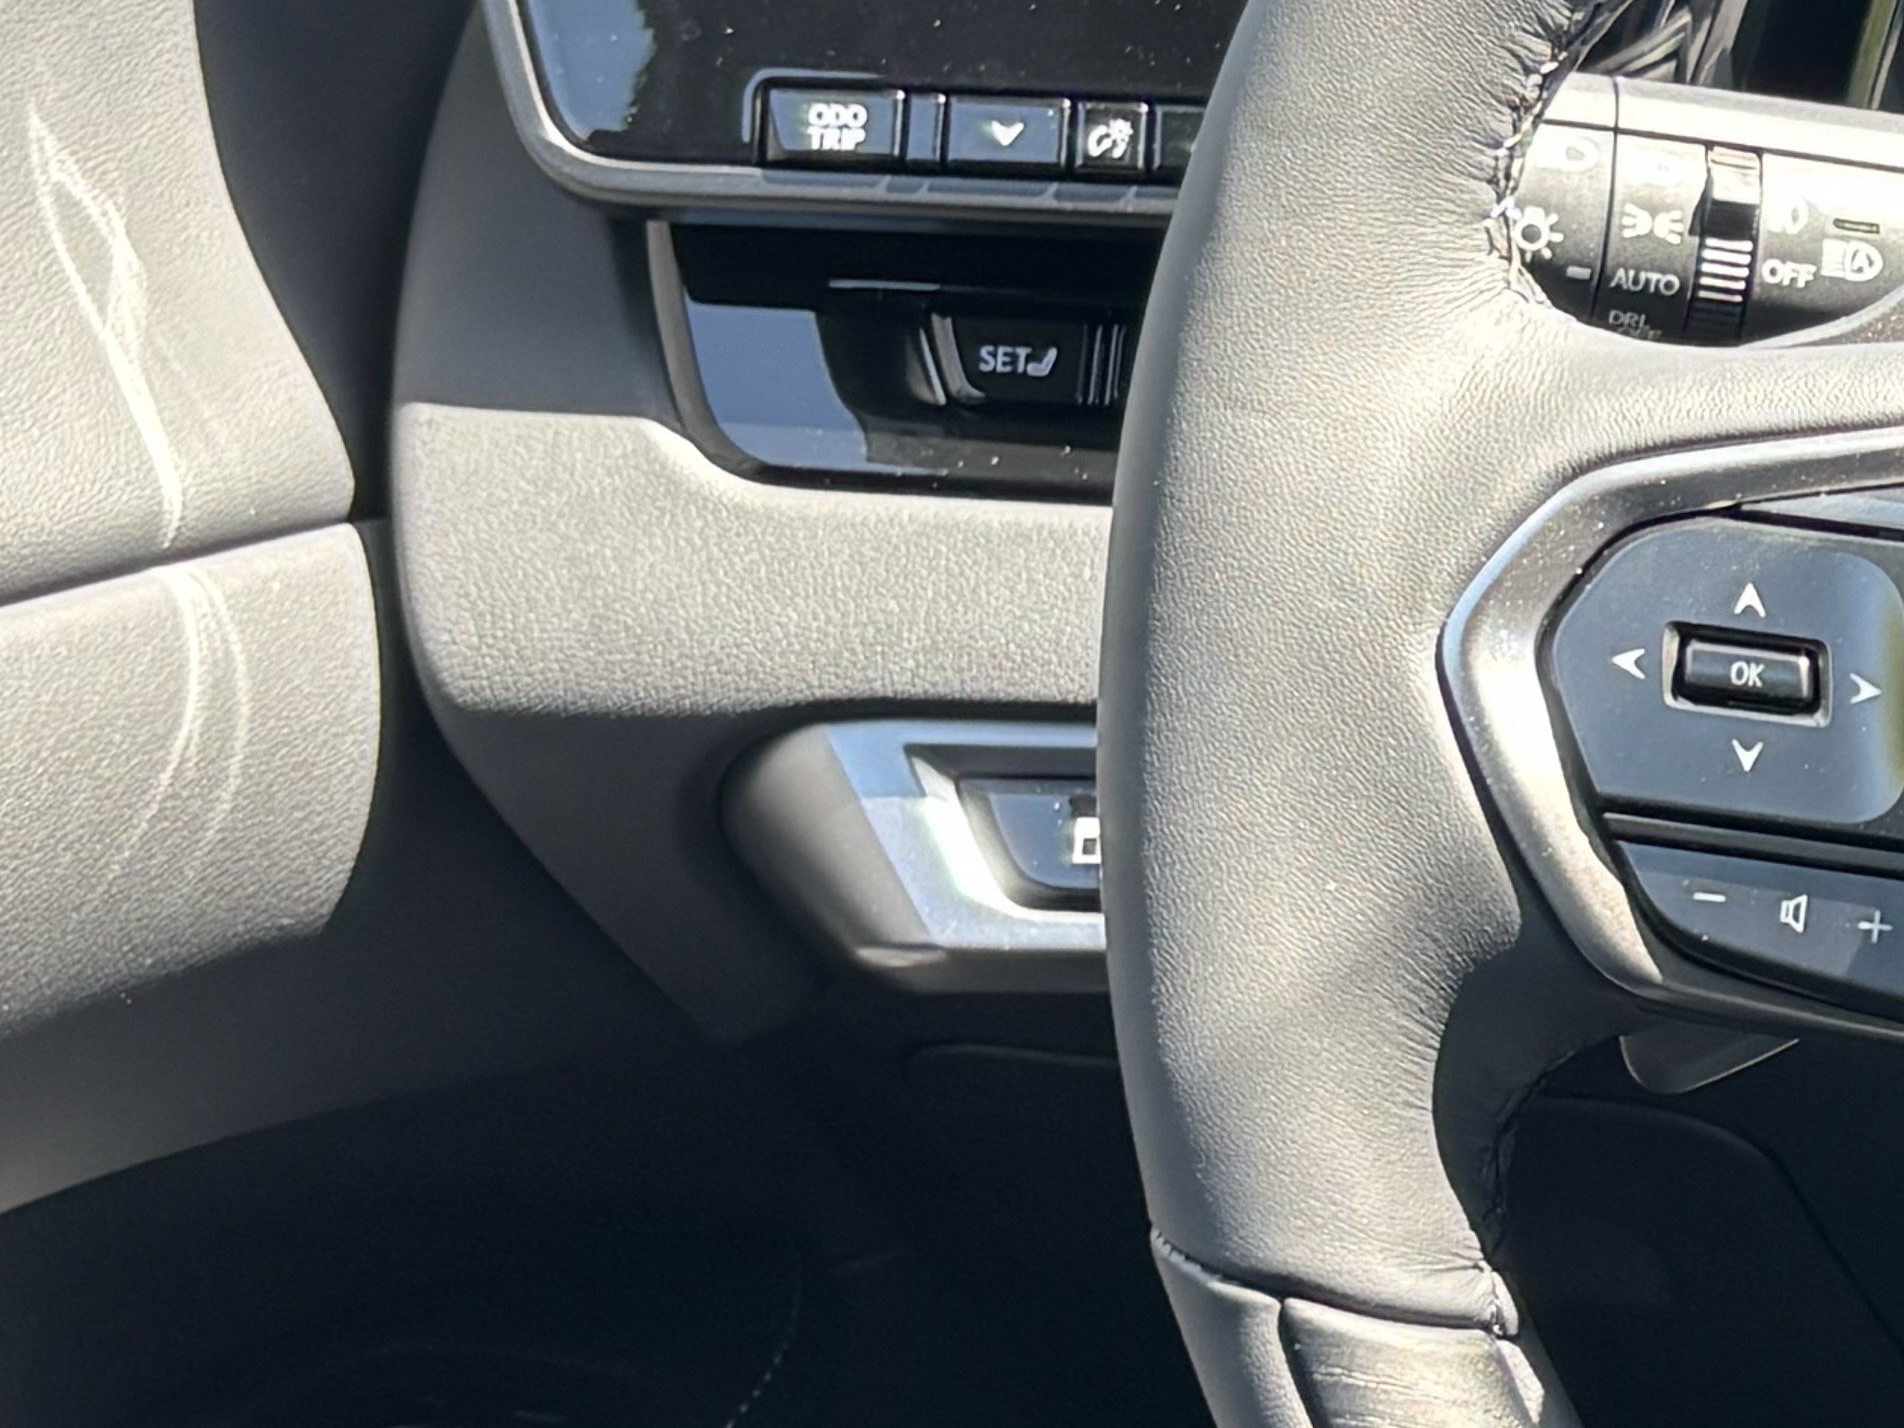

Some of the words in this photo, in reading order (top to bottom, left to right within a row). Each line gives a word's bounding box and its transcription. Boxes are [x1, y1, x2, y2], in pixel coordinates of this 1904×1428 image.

[808, 103, 868, 128] ODO
[807, 127, 867, 151] TRIP
[1609, 268, 1681, 296] AUTO
[1761, 258, 1817, 289] OFF
[1608, 309, 1650, 329] DRL
[979, 346, 1032, 375] SET
[1729, 661, 1765, 688] OK
